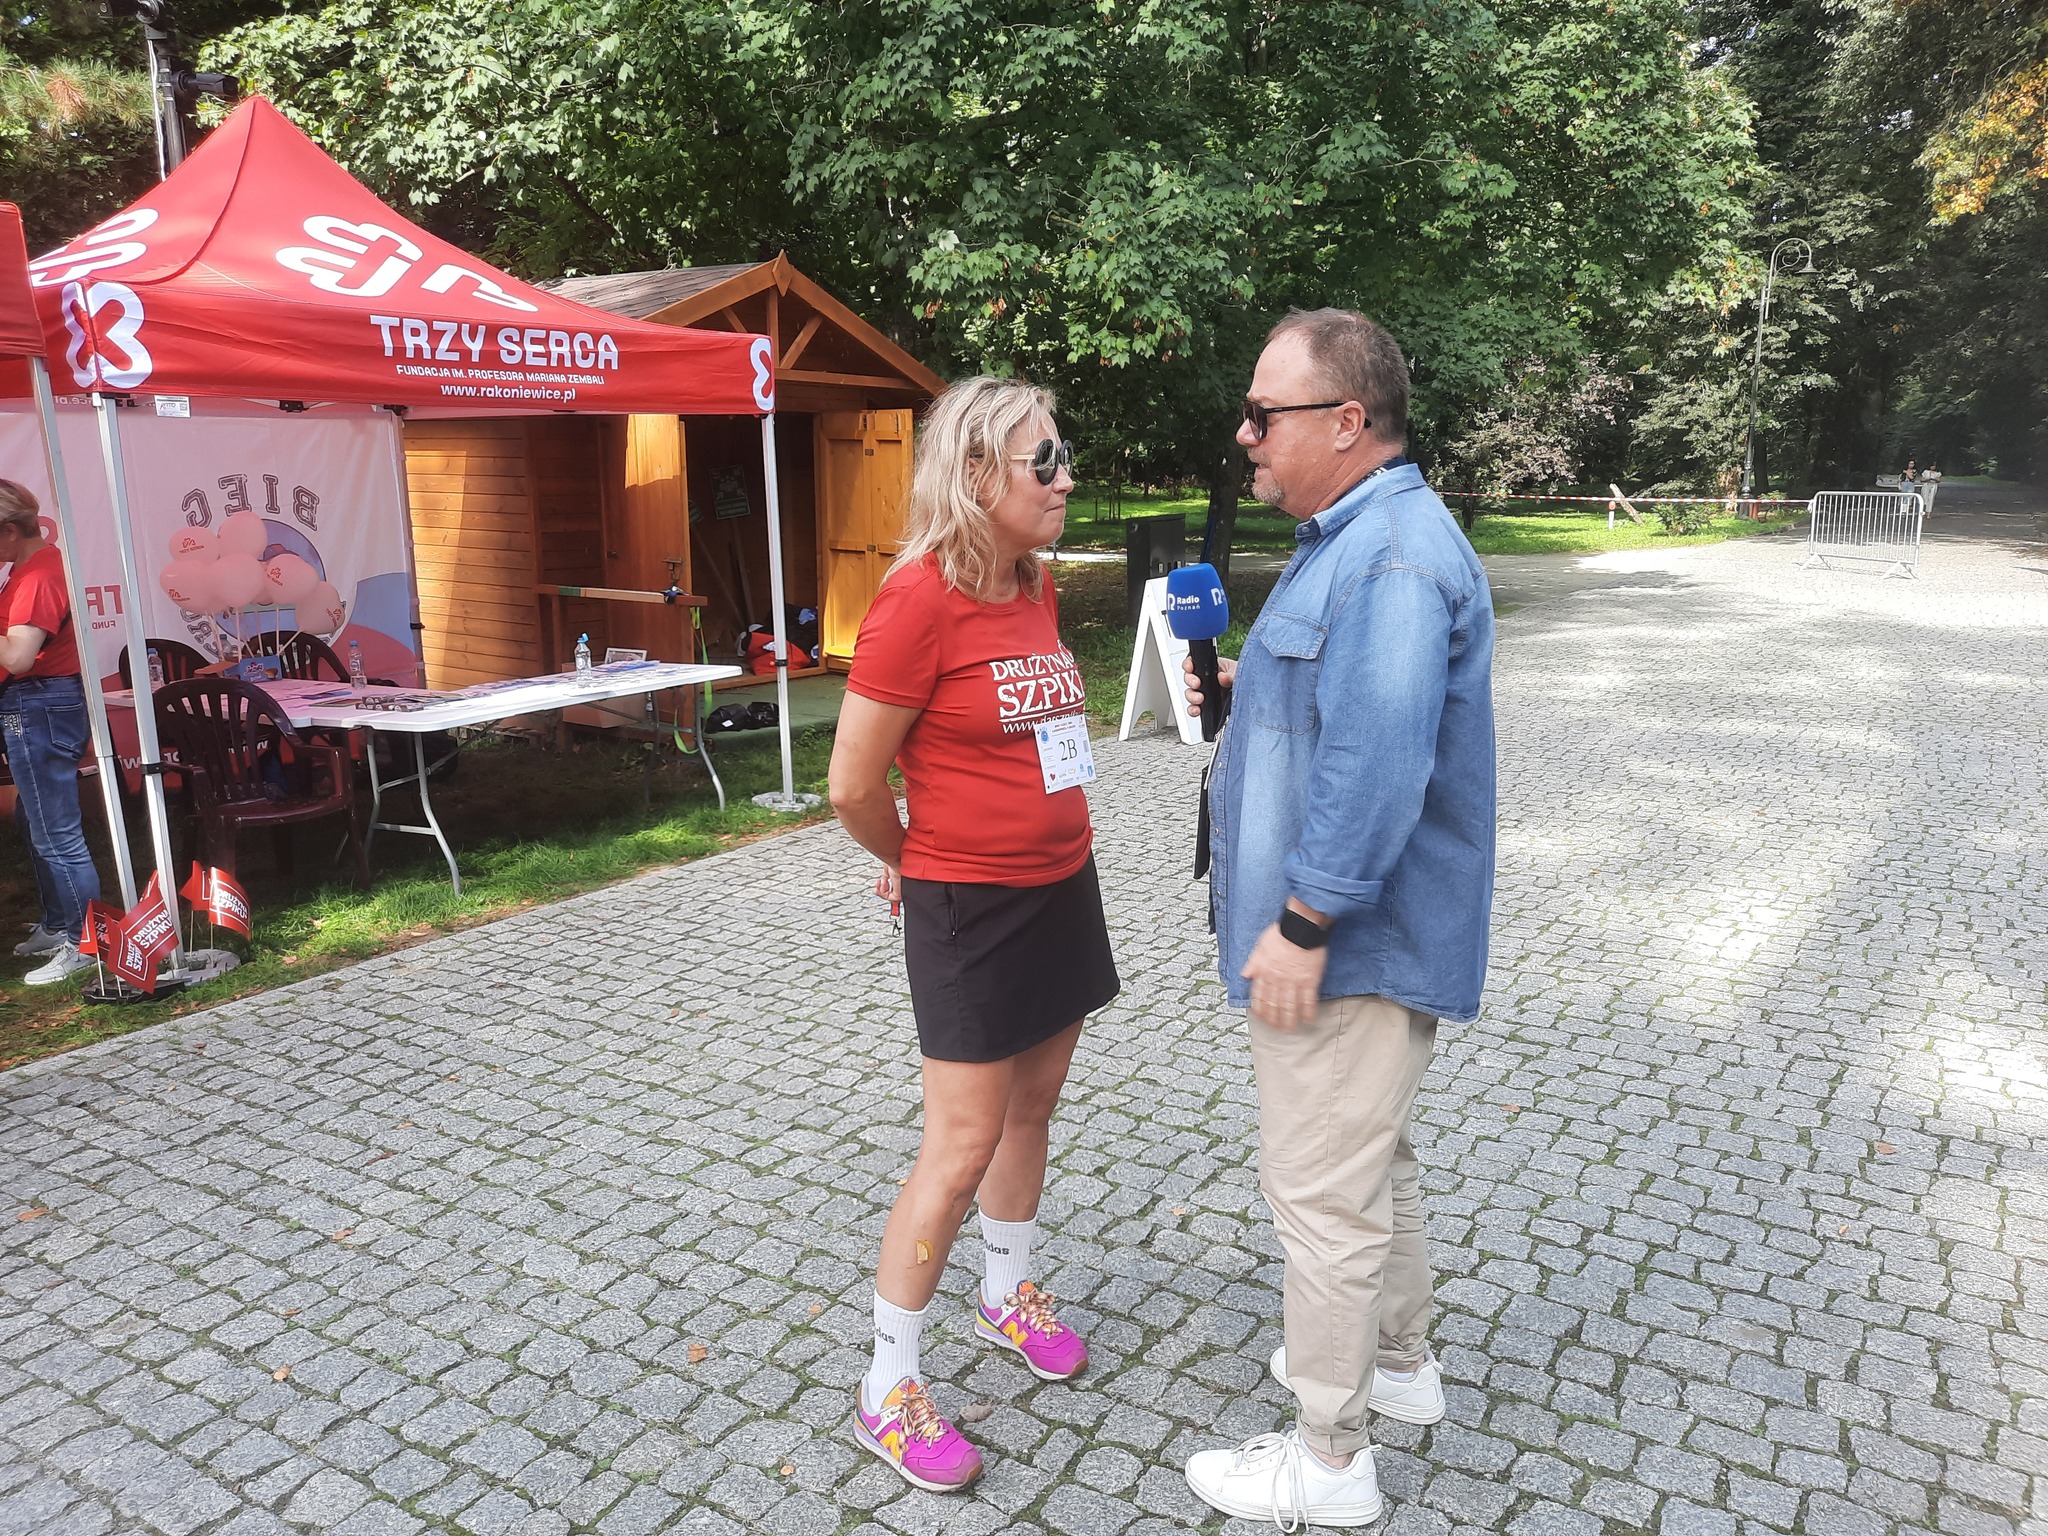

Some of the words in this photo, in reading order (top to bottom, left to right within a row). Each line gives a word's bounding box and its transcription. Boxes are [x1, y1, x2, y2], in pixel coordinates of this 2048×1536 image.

[370, 315, 486, 362] TRZY
[497, 327, 619, 370] SERCA
[396, 364, 451, 378] FUNDACJA
[468, 370, 525, 382] PROFESORA
[526, 372, 567, 384] MARIANA
[441, 384, 576, 403] www.rakoniewice.pl
[1177, 595, 1200, 605] Radio
[989, 652, 1074, 681] DRUŻYNA
[1058, 738, 1078, 761] 2B
